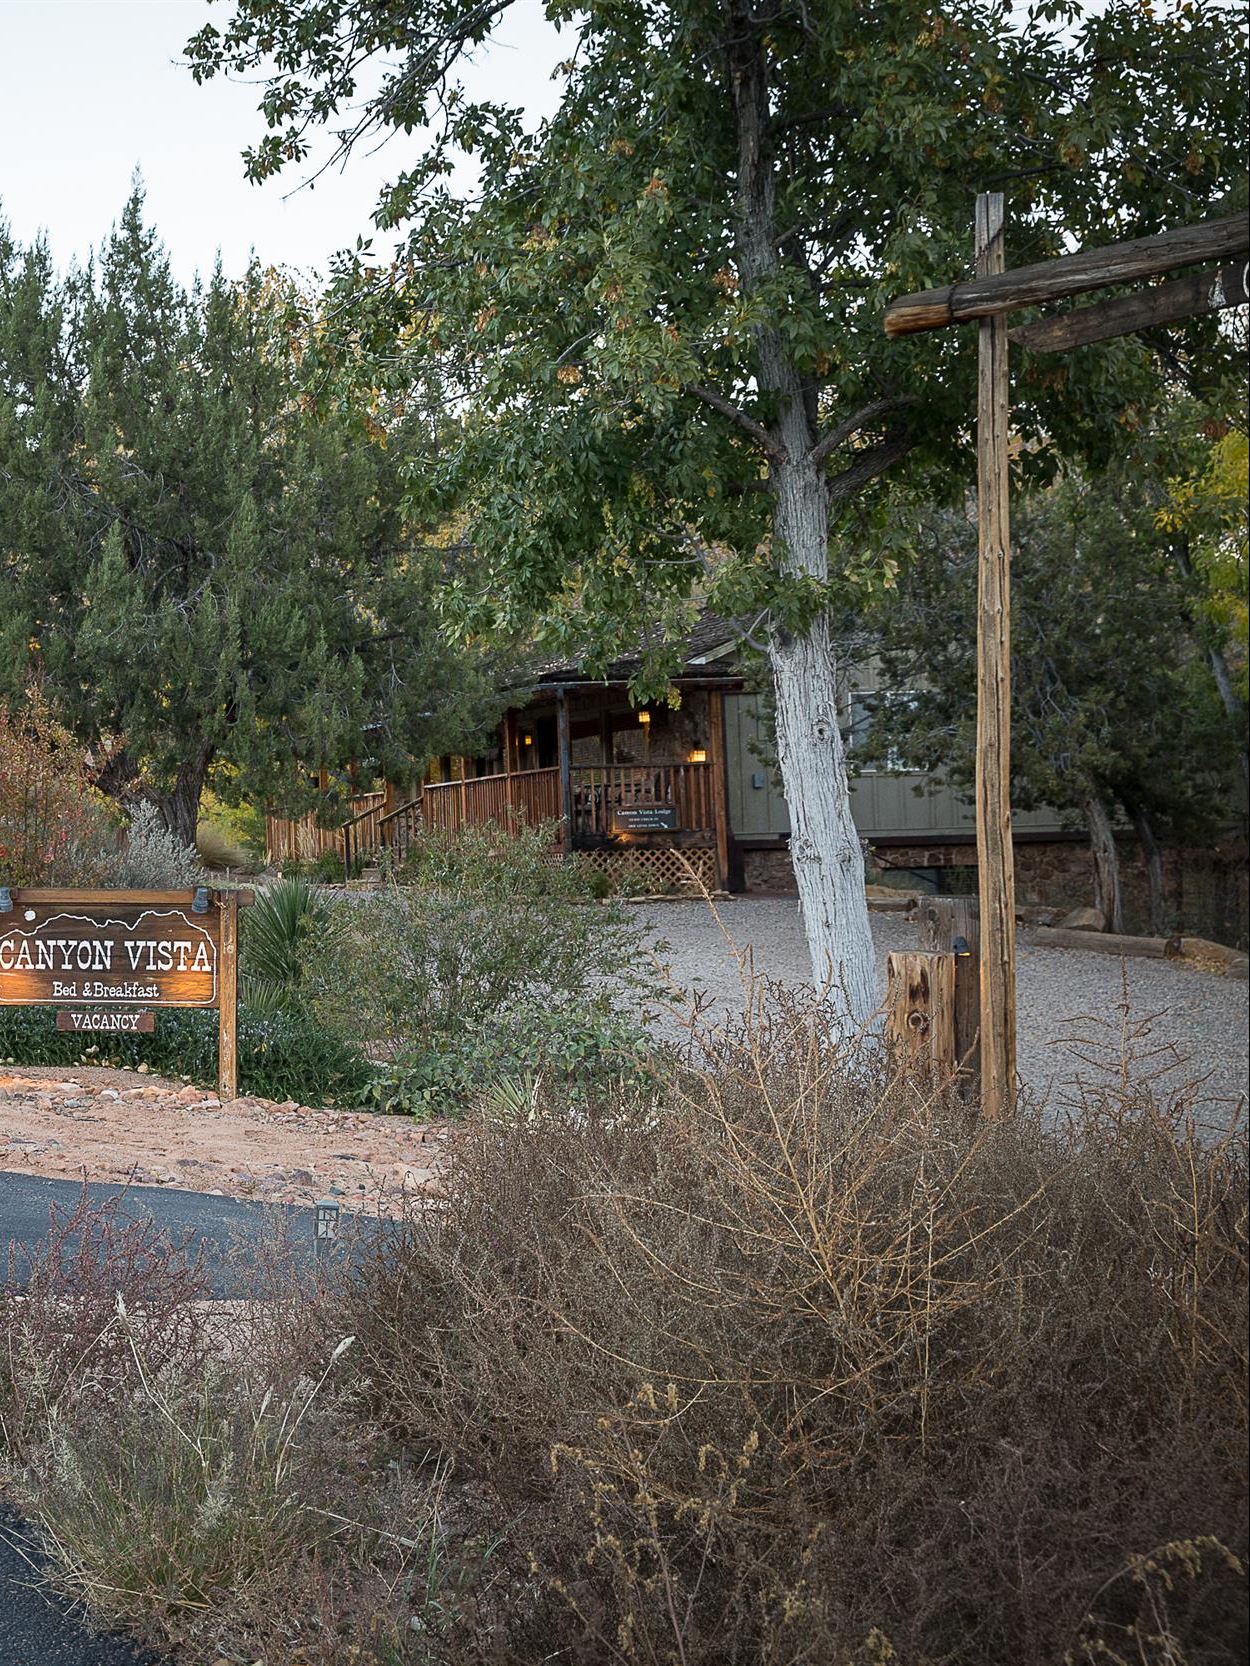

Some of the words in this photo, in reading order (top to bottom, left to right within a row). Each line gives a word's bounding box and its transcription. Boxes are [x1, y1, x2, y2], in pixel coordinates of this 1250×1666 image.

[0, 940, 114, 970] CANYON
[124, 940, 212, 972] VISTA
[53, 981, 77, 997] Bed
[93, 982, 160, 998] Breakfast
[71, 1014, 140, 1030] VACANCY
